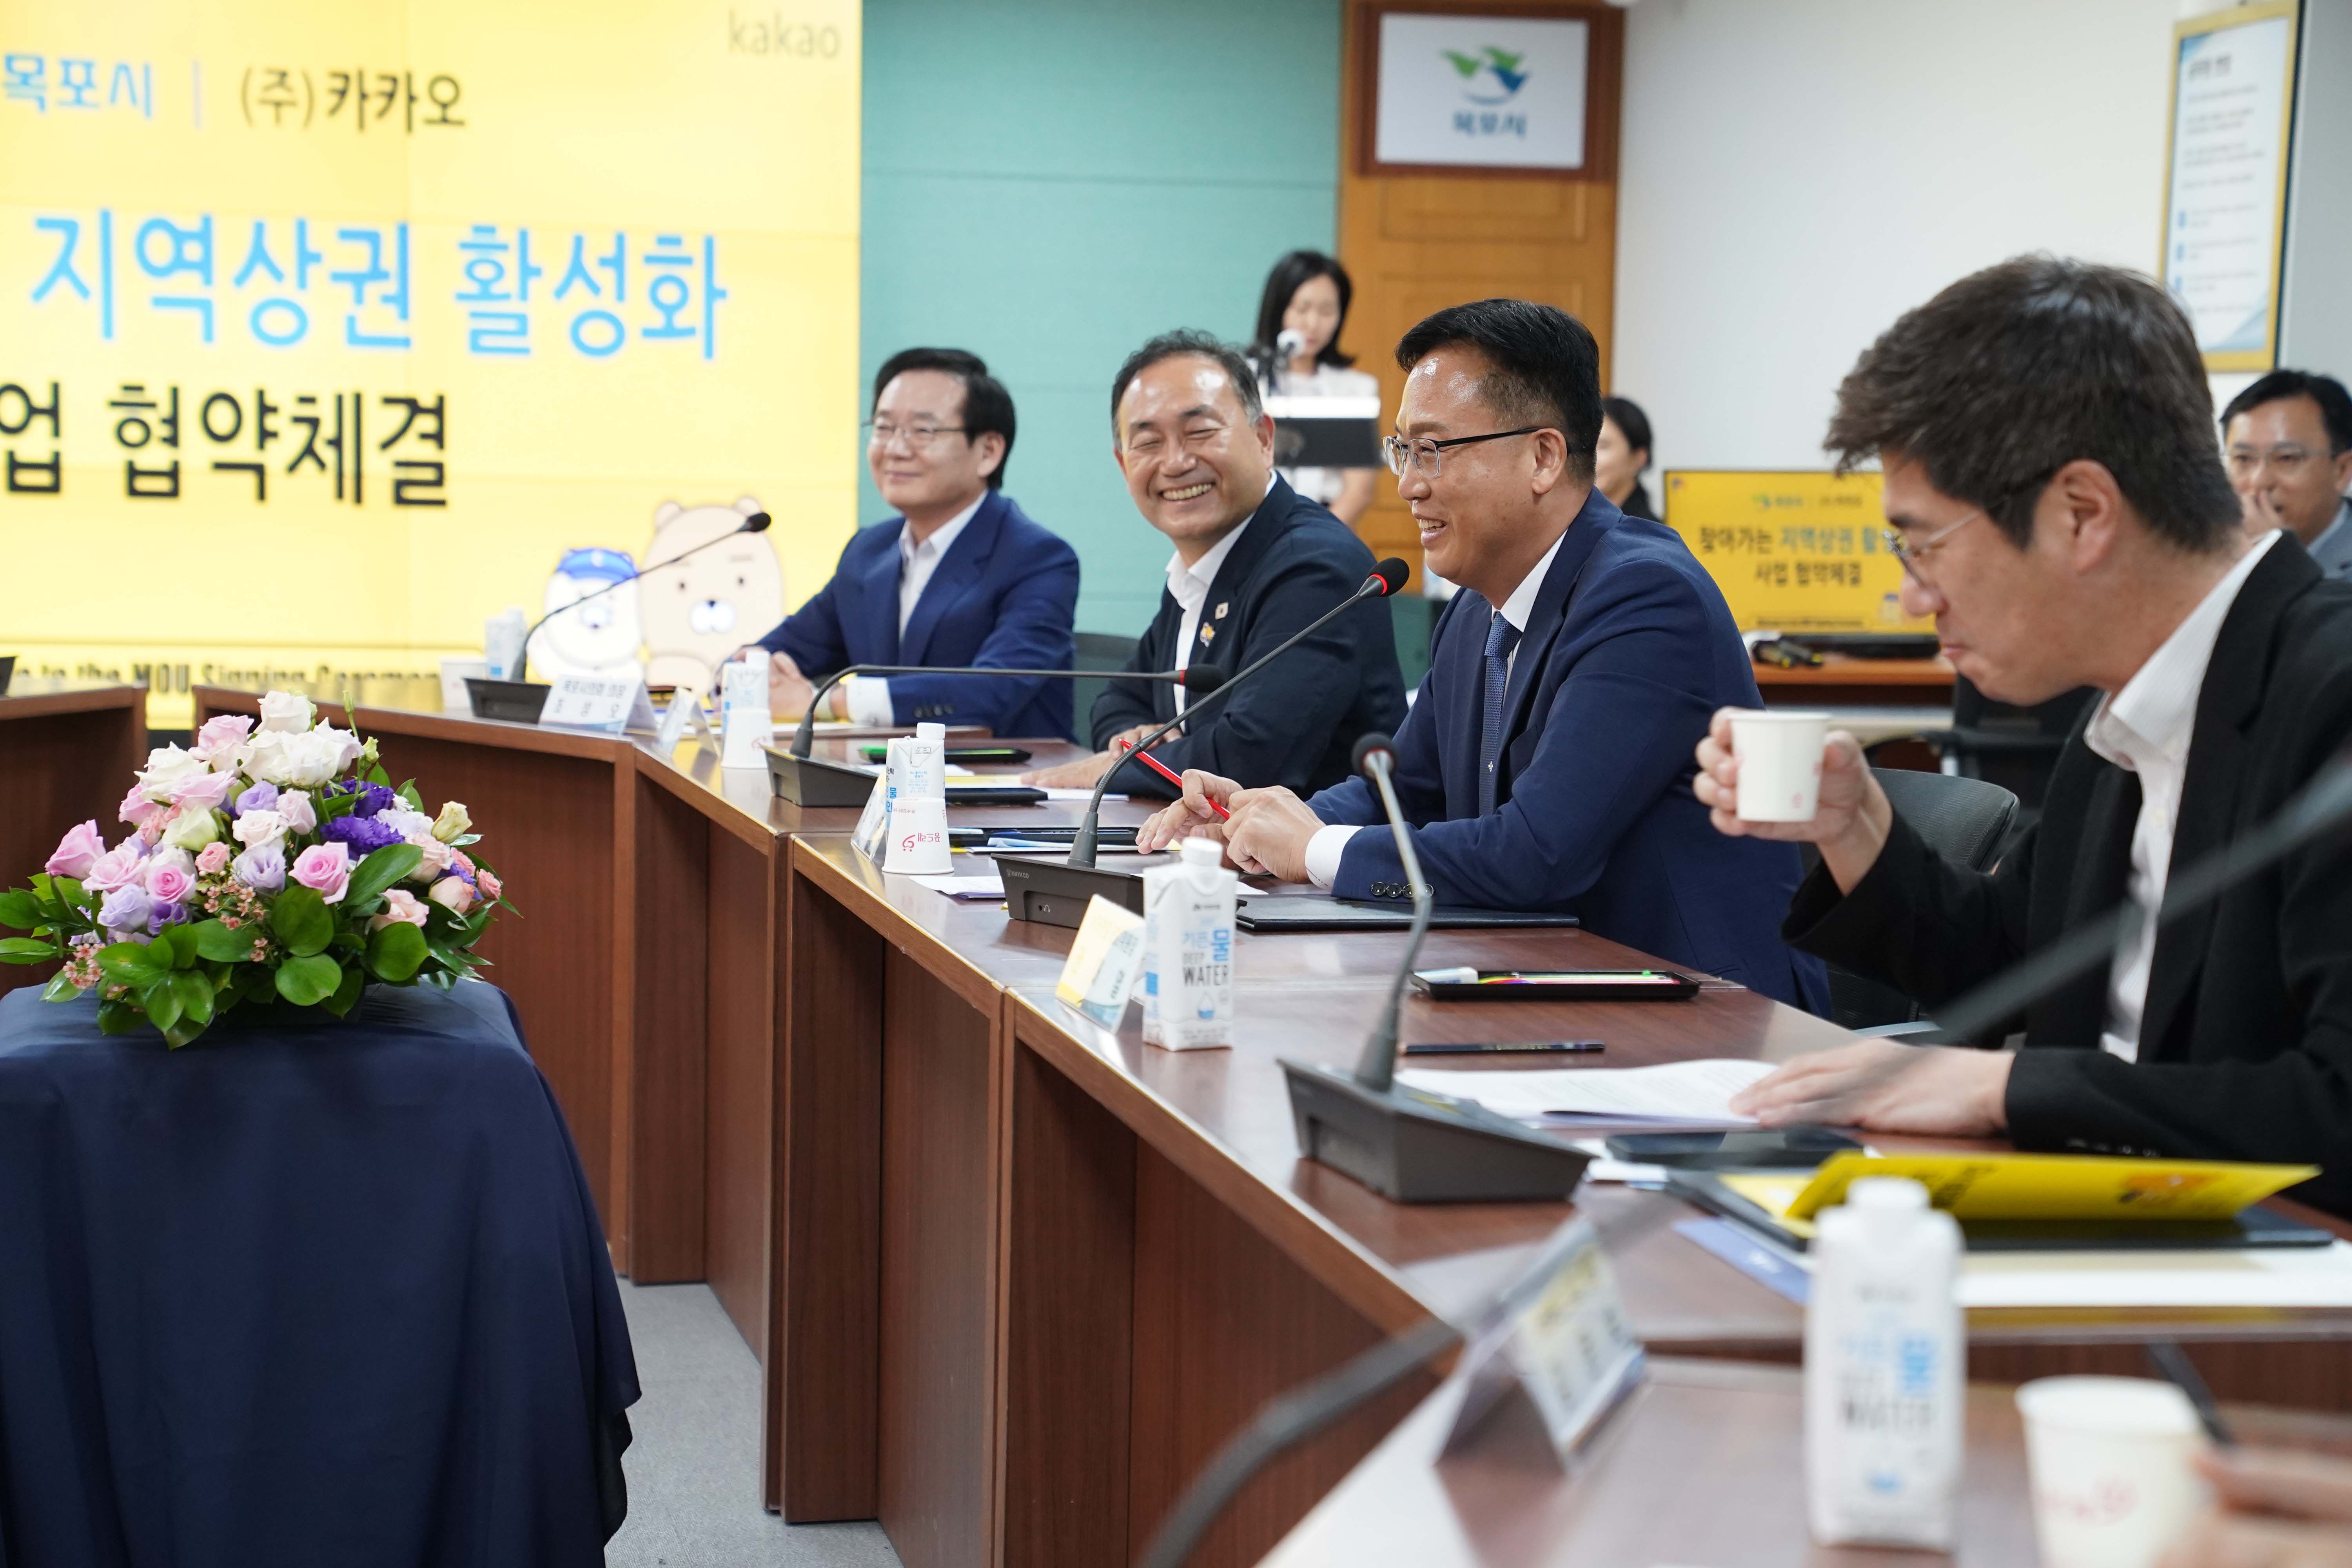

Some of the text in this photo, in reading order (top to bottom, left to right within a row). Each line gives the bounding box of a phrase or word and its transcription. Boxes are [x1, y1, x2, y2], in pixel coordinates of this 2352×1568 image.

[728, 10, 842, 59] kakao
[2, 53, 152, 119] 목포시
[31, 209, 728, 361] 지역상권 활성화
[107, 385, 447, 506] 협약체결
[917, 832, 941, 842] 꿈드래
[1183, 965, 1229, 987] WATER
